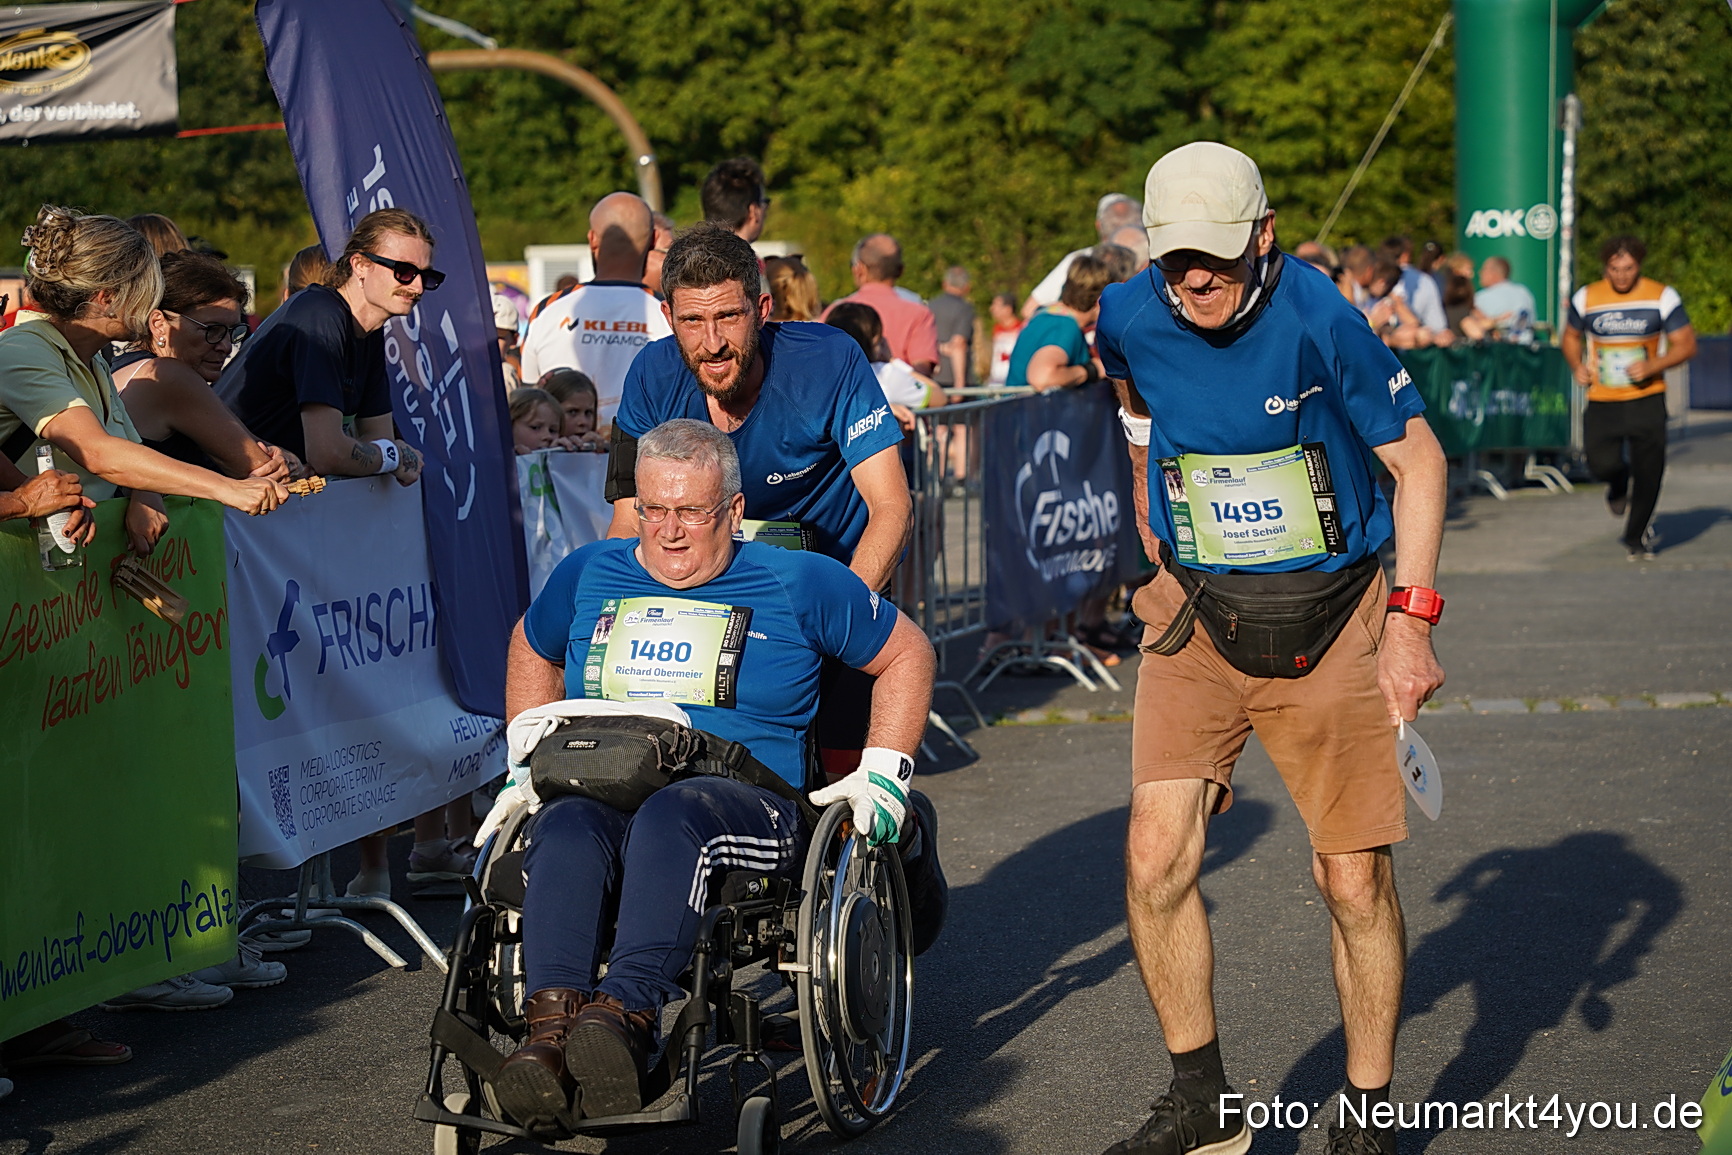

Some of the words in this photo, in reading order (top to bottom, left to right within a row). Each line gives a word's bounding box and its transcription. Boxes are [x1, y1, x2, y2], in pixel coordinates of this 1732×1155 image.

[8, 104, 42, 121] der
[1465, 208, 1527, 238] AOK
[1304, 449, 1315, 476] RABATT
[1210, 498, 1283, 524] 1495
[1222, 528, 1250, 539] Josef
[1252, 525, 1287, 537] Schöll
[1323, 514, 1337, 546] HILTL
[0, 554, 103, 667] Gesunde
[727, 611, 737, 635] RABATT
[630, 639, 692, 663] 1480
[41, 640, 123, 732] laufen
[615, 666, 651, 676] Richard
[653, 667, 703, 679] Obermeier
[718, 668, 727, 701] HILTL
[449, 713, 493, 744] HEUTE
[300, 740, 382, 779] MEDIALOGISTICS
[300, 770, 355, 805] CORPORATE
[355, 762, 386, 787] PRINT
[301, 795, 357, 831] CORPORATE
[357, 782, 397, 812] SIGNAGE
